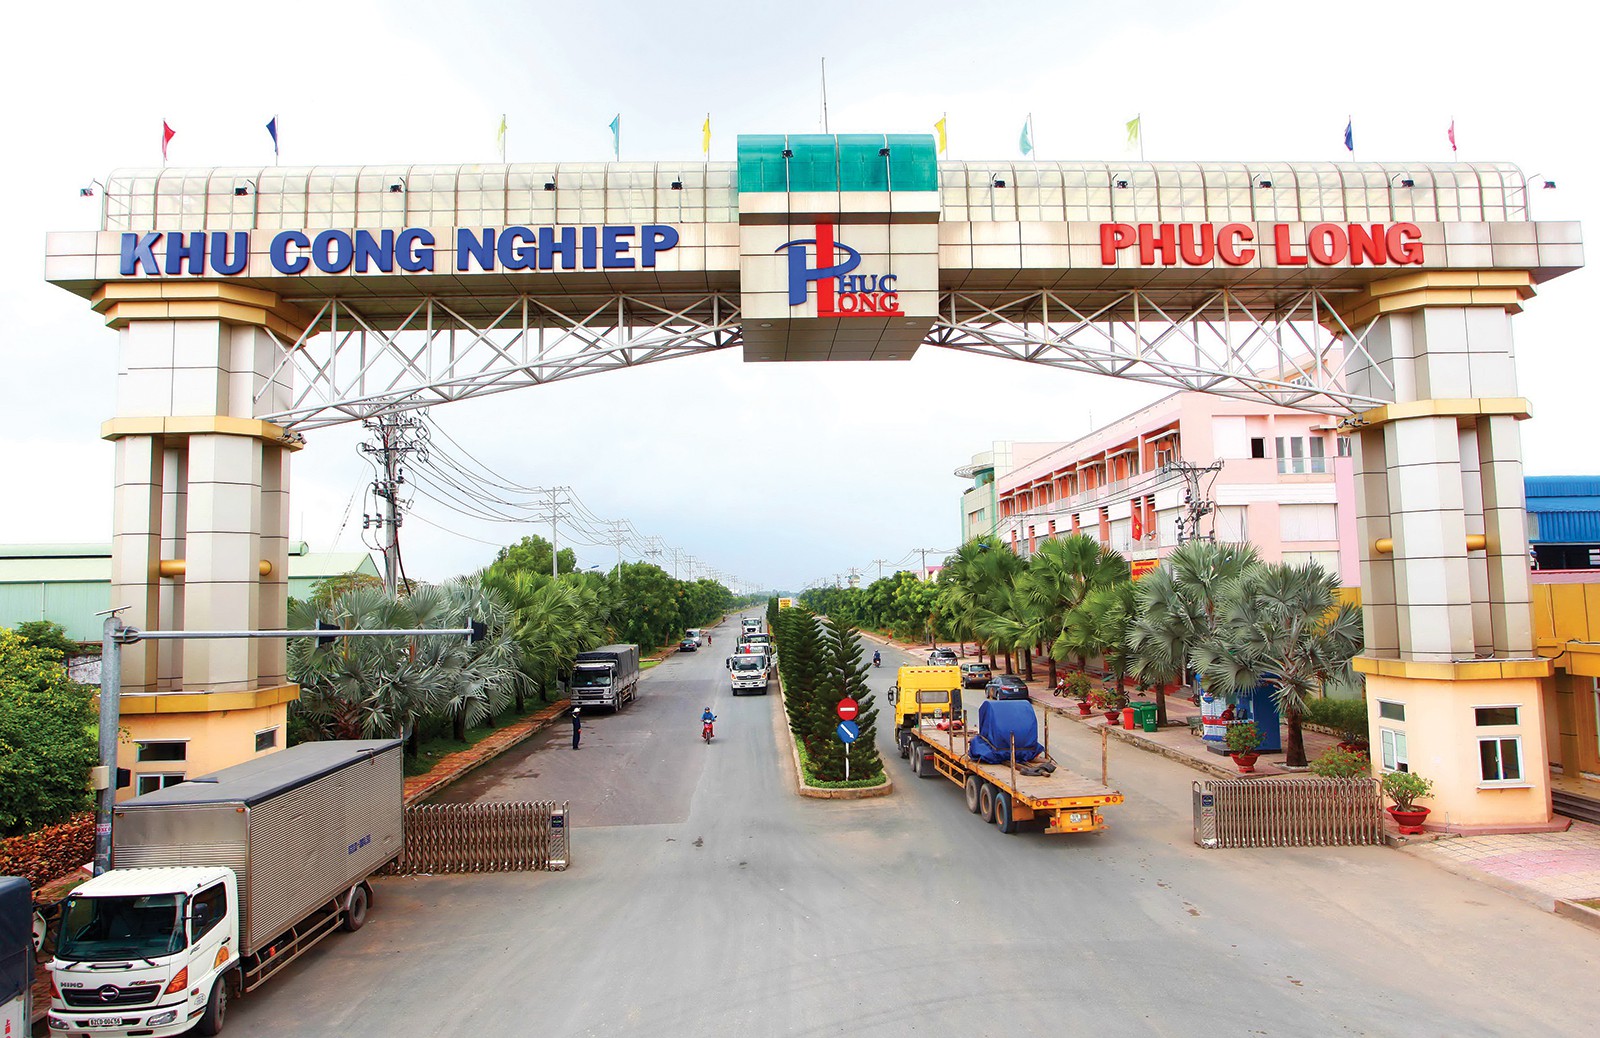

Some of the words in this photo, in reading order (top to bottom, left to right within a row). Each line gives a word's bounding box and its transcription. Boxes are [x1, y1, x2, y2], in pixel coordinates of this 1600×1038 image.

[120, 230, 249, 276] KHU
[269, 227, 435, 275] CONG
[456, 224, 679, 272] NGHIEP
[1100, 223, 1256, 266] PHUC
[1274, 222, 1425, 266] LONG
